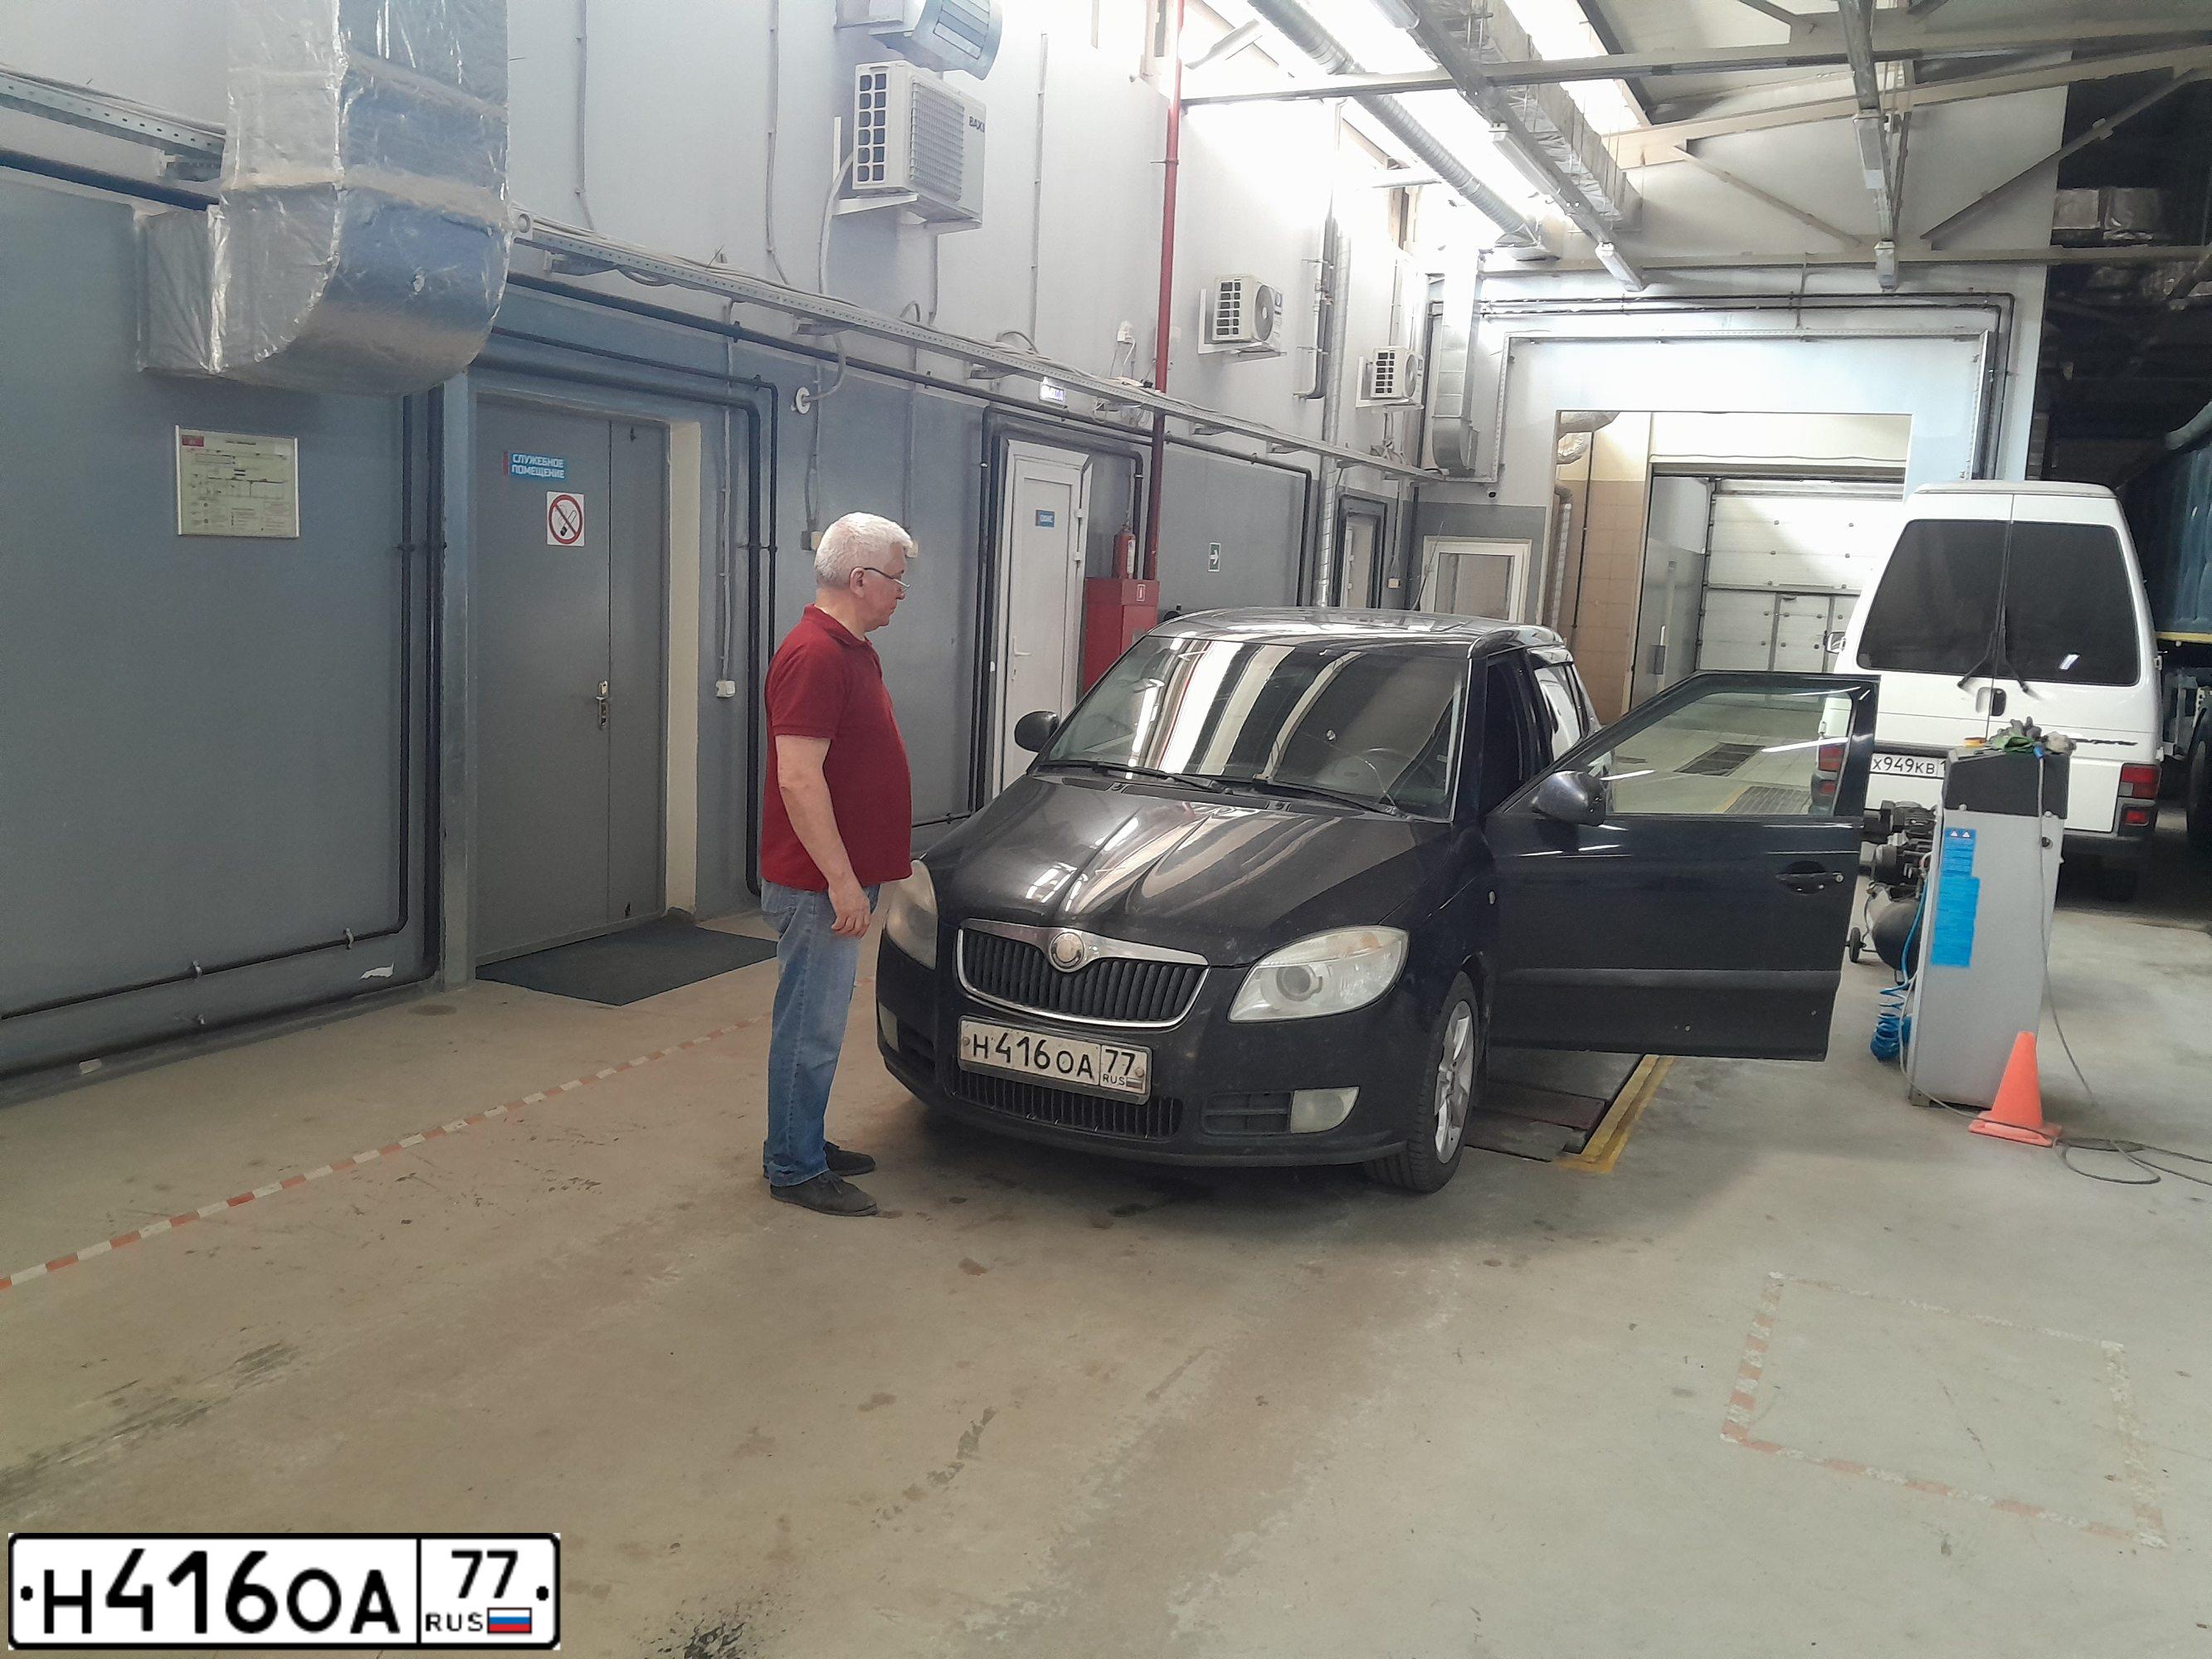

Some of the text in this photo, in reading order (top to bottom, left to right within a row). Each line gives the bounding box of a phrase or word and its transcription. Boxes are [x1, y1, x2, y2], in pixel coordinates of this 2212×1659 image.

[512, 454, 564, 468] СЛУЖЕБНОЕ
[511, 464, 565, 479] ПОМЕЩЕНИЕ
[1105, 1048, 1136, 1077] 77
[1102, 1073, 1126, 1087] RUS
